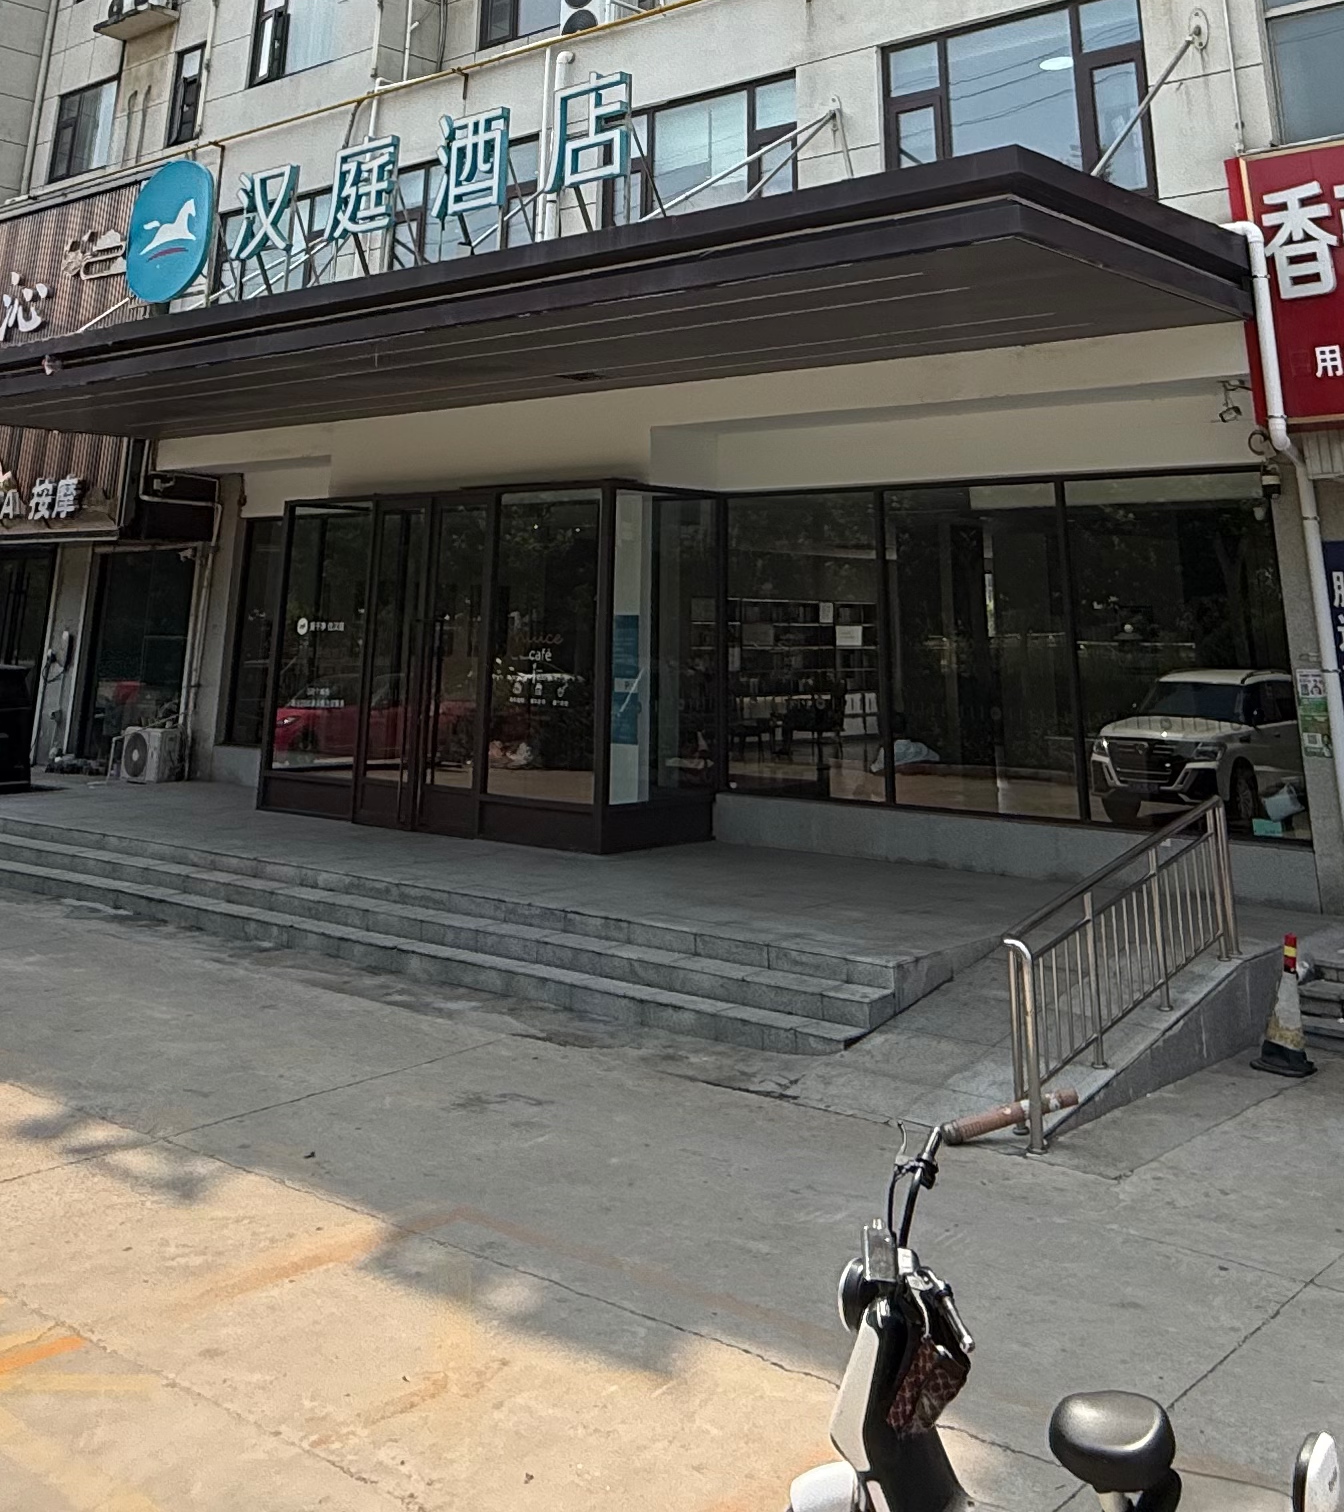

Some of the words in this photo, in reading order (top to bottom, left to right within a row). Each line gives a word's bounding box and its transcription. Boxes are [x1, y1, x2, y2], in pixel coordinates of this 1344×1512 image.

[230, 71, 633, 261] 汉庭酒店
[27, 473, 83, 521] 按摩
[528, 647, 552, 662] café
